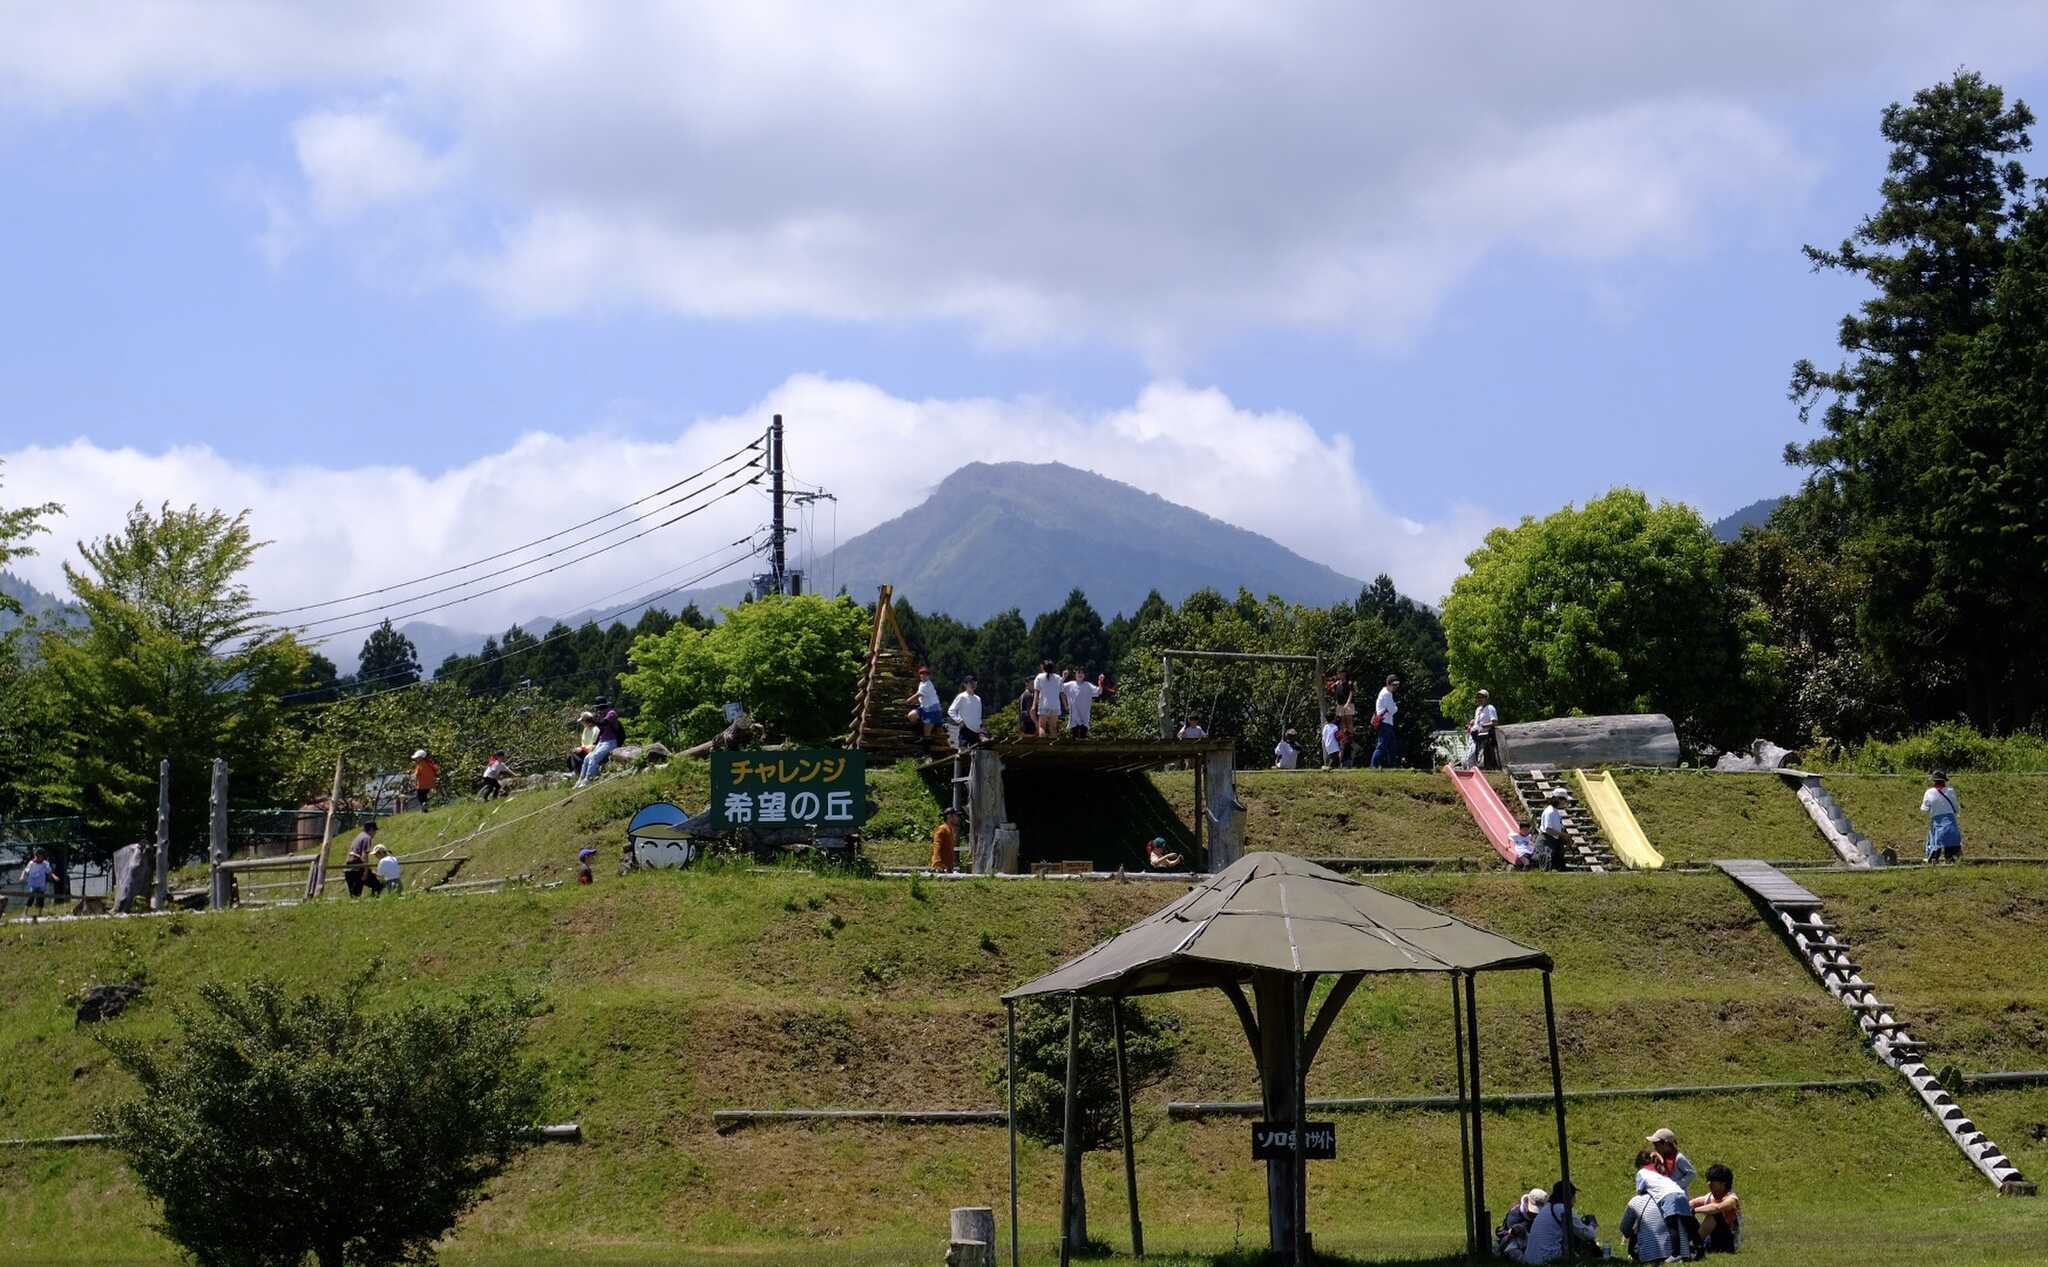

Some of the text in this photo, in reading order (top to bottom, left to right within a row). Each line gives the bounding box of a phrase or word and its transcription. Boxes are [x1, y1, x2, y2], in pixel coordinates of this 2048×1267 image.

[730, 758, 846, 785] チャレンジ
[724, 791, 854, 823] 希望の丘
